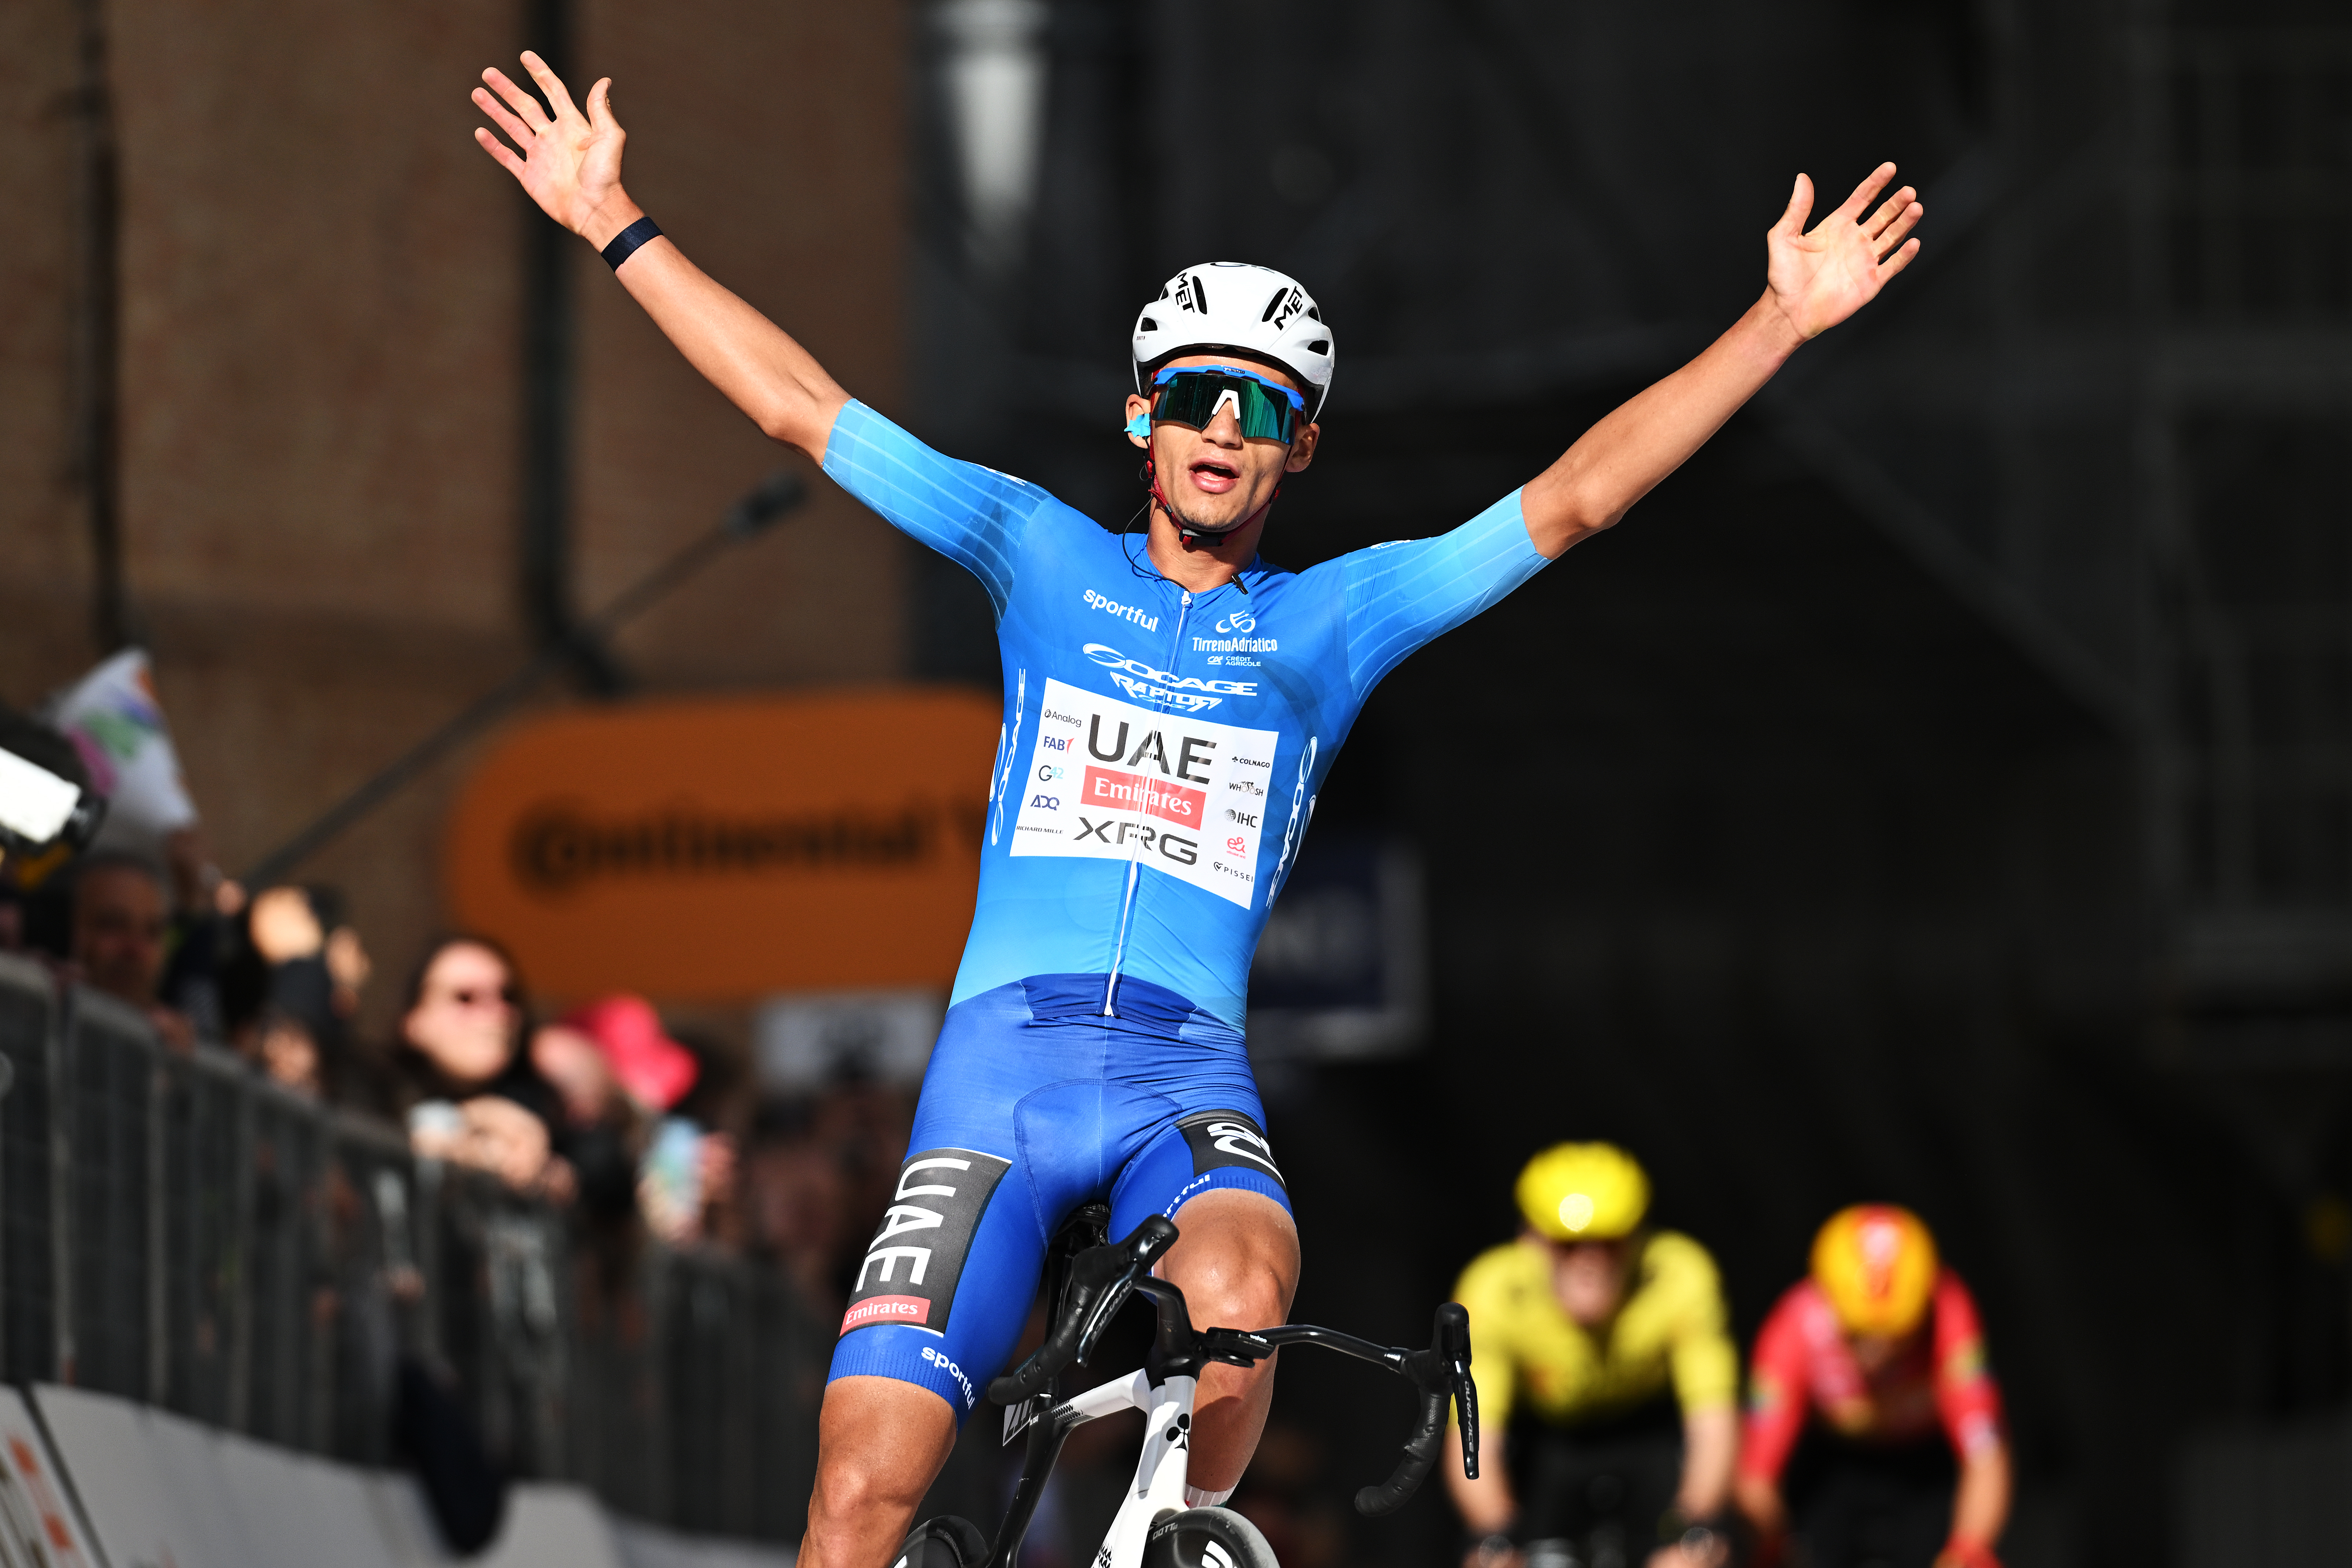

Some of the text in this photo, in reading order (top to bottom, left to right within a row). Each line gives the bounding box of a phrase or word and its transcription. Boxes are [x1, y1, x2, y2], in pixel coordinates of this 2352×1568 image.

[1175, 272, 1195, 313] MET
[1274, 286, 1303, 331] MET
[1083, 589, 1159, 632] sportful
[1193, 637, 1277, 652] TirrenoAdriatico
[1110, 670, 1223, 712] RAPTOR
[1051, 711, 1082, 727] Analog
[1088, 713, 1217, 785] UAE
[1240, 758, 1270, 768] COLNAGO
[1039, 765, 1064, 781] G42
[1030, 795, 1060, 811] ADQ
[1094, 777, 1192, 816] Emirates
[1237, 812, 1258, 828] IHC
[1073, 817, 1198, 865] XRG
[1224, 866, 1253, 882] PISSEI
[1163, 1174, 1210, 1218] rtful
[855, 1157, 971, 1292] UAE
[846, 1302, 918, 1325] Emirates
[921, 1347, 975, 1410] sportful
